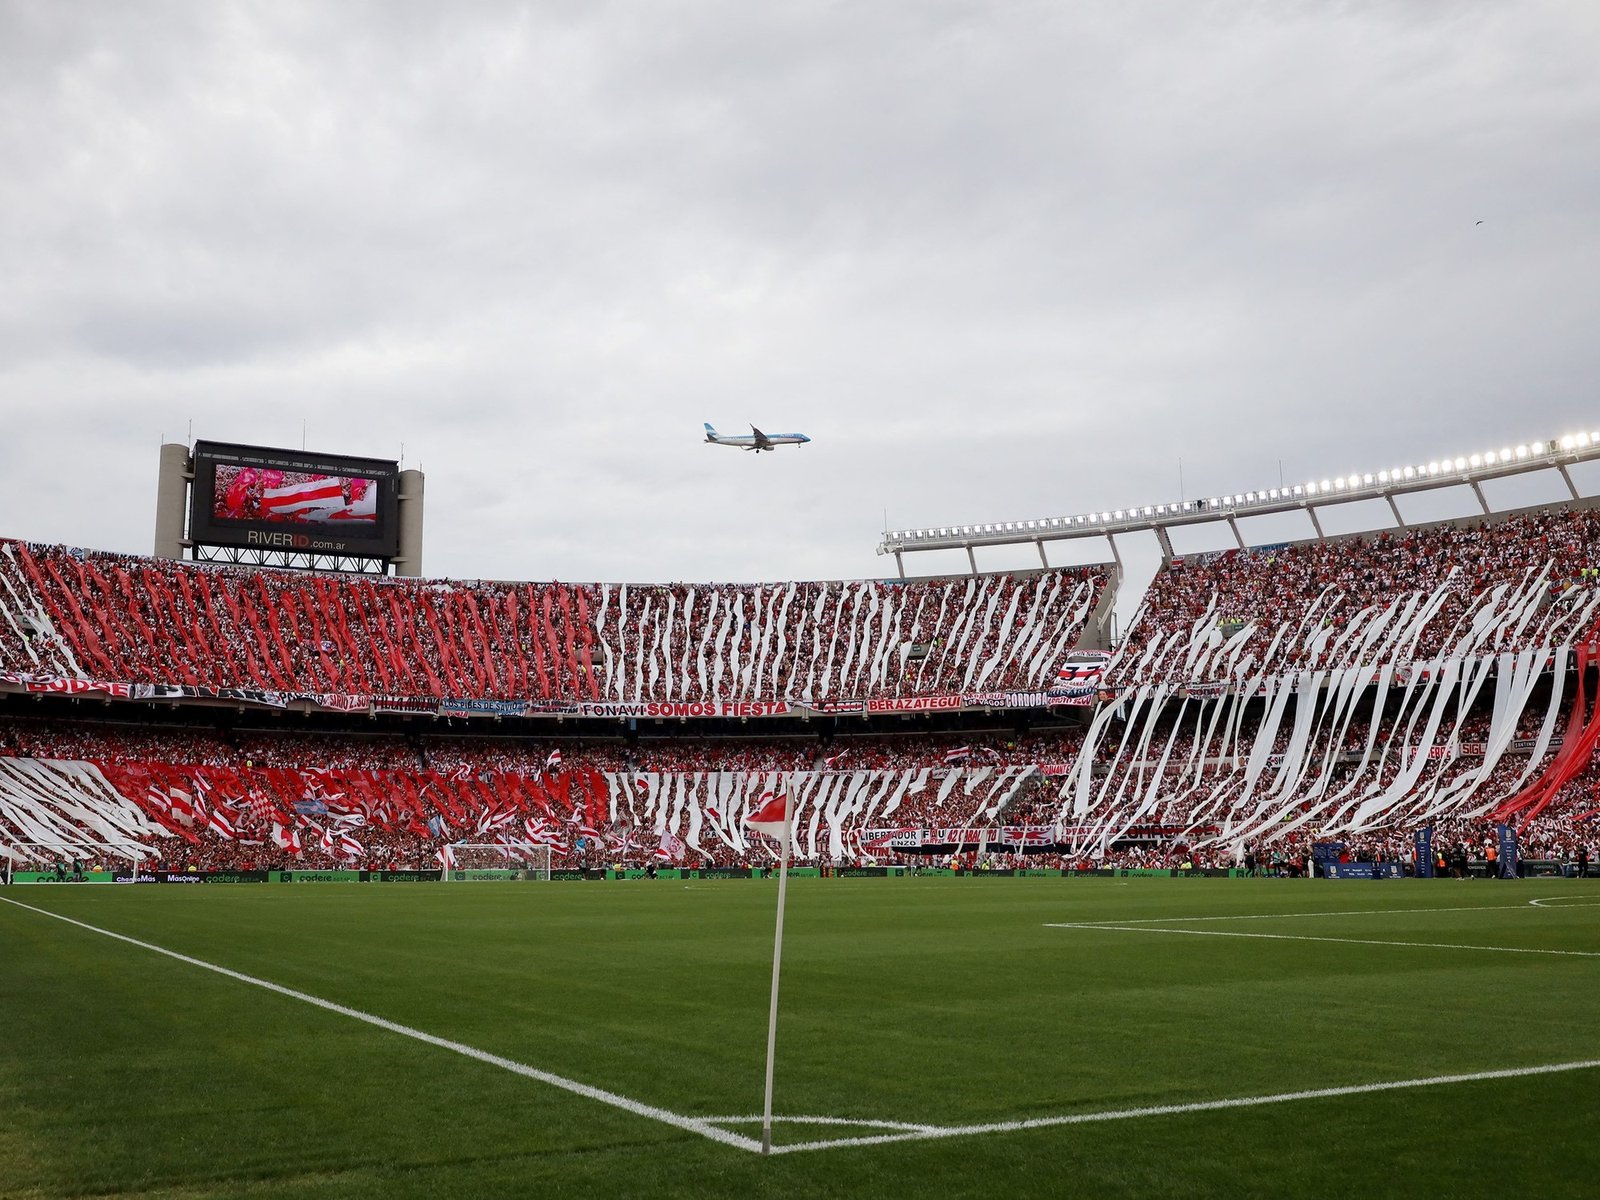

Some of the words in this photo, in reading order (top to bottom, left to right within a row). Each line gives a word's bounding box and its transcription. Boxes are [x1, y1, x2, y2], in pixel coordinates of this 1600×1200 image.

[444, 700, 459, 708] LOS
[460, 701, 482, 709] PIBES
[483, 702, 494, 710] DE
[583, 704, 645, 716] FONAVI
[647, 702, 716, 717] SOMOS
[722, 702, 788, 716] FIESTA
[869, 697, 961, 712] BERAZATEGUI
[860, 830, 917, 841] LIBERTADOR
[206, 874, 240, 883] codere
[300, 873, 332, 882] codere
[388, 873, 420, 882] codere
